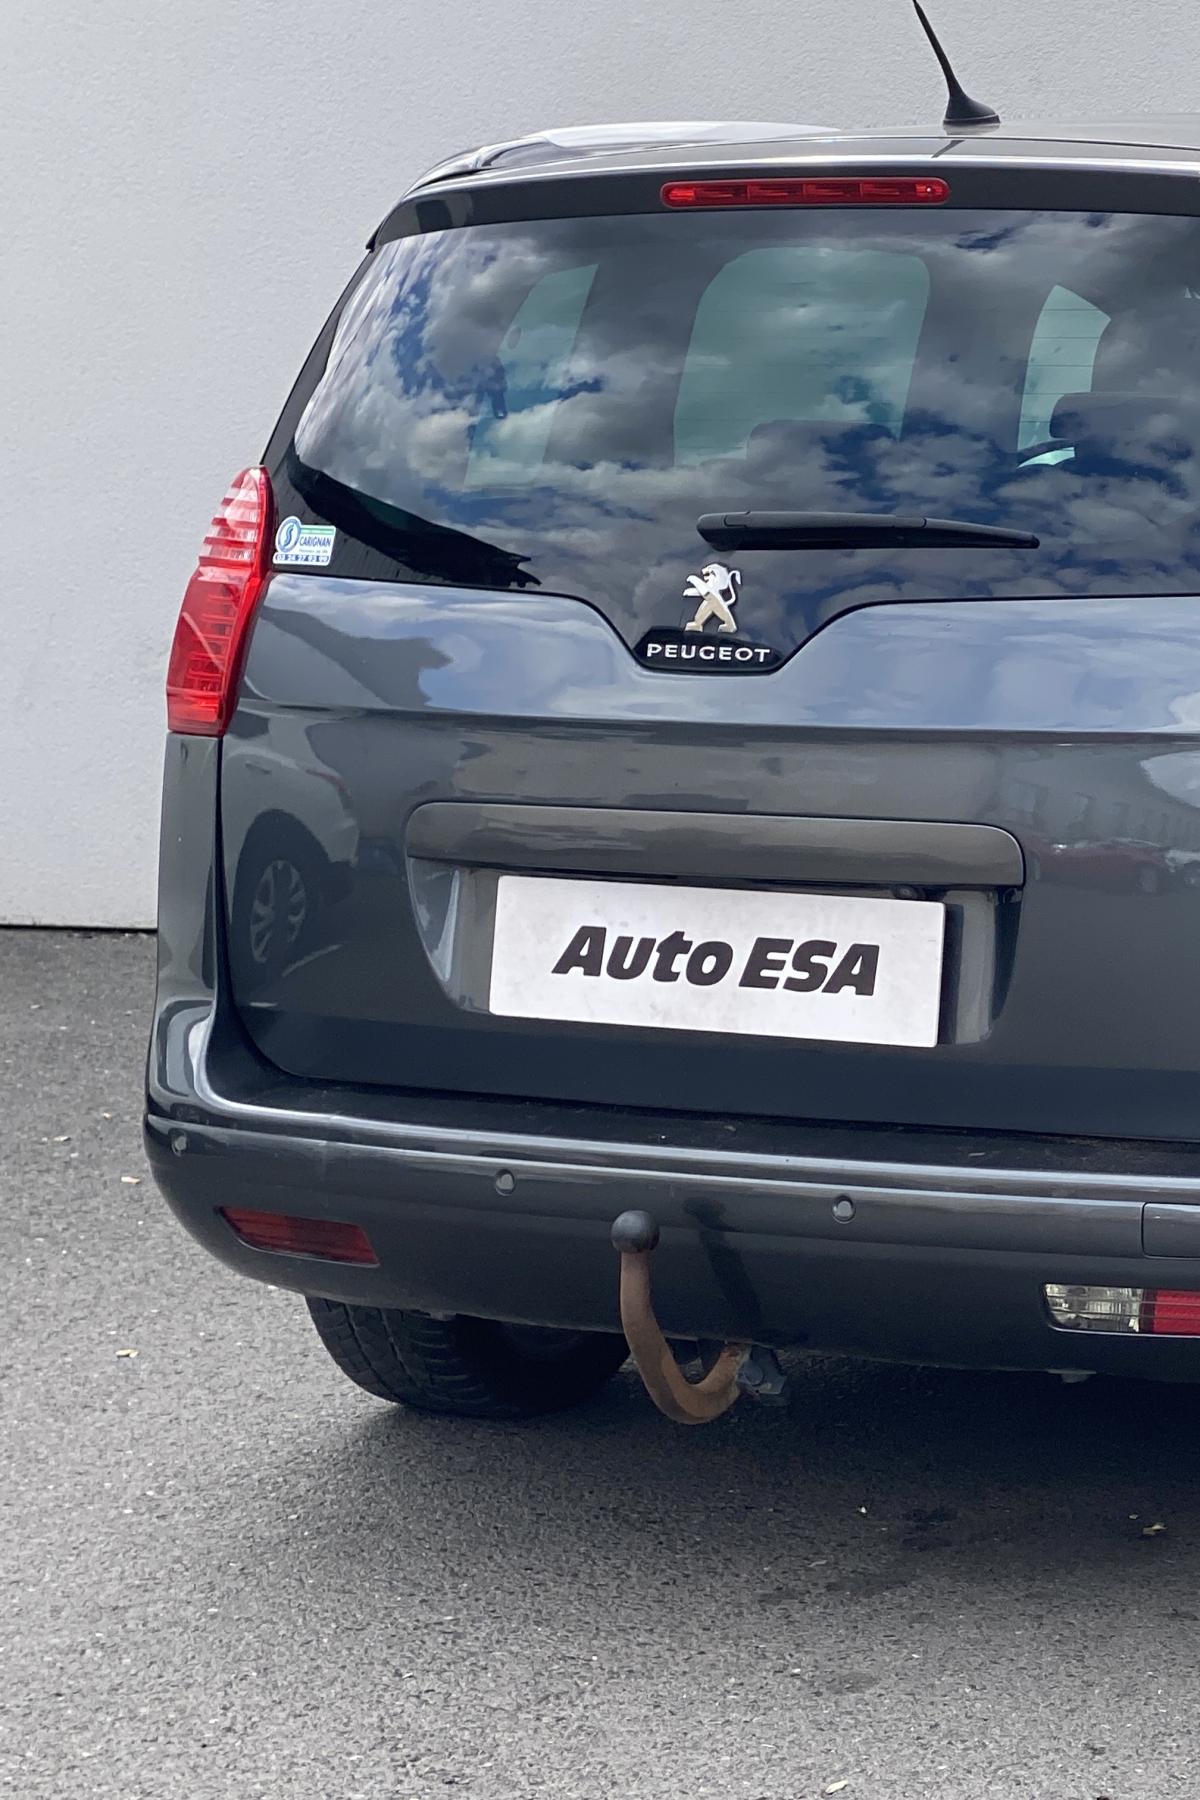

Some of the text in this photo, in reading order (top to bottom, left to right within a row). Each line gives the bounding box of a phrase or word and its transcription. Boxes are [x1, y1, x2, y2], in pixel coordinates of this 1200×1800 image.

[300, 536, 331, 547] CARIGNAN
[646, 643, 770, 662] PEUGEOT
[551, 925, 880, 997] Auto ESA
